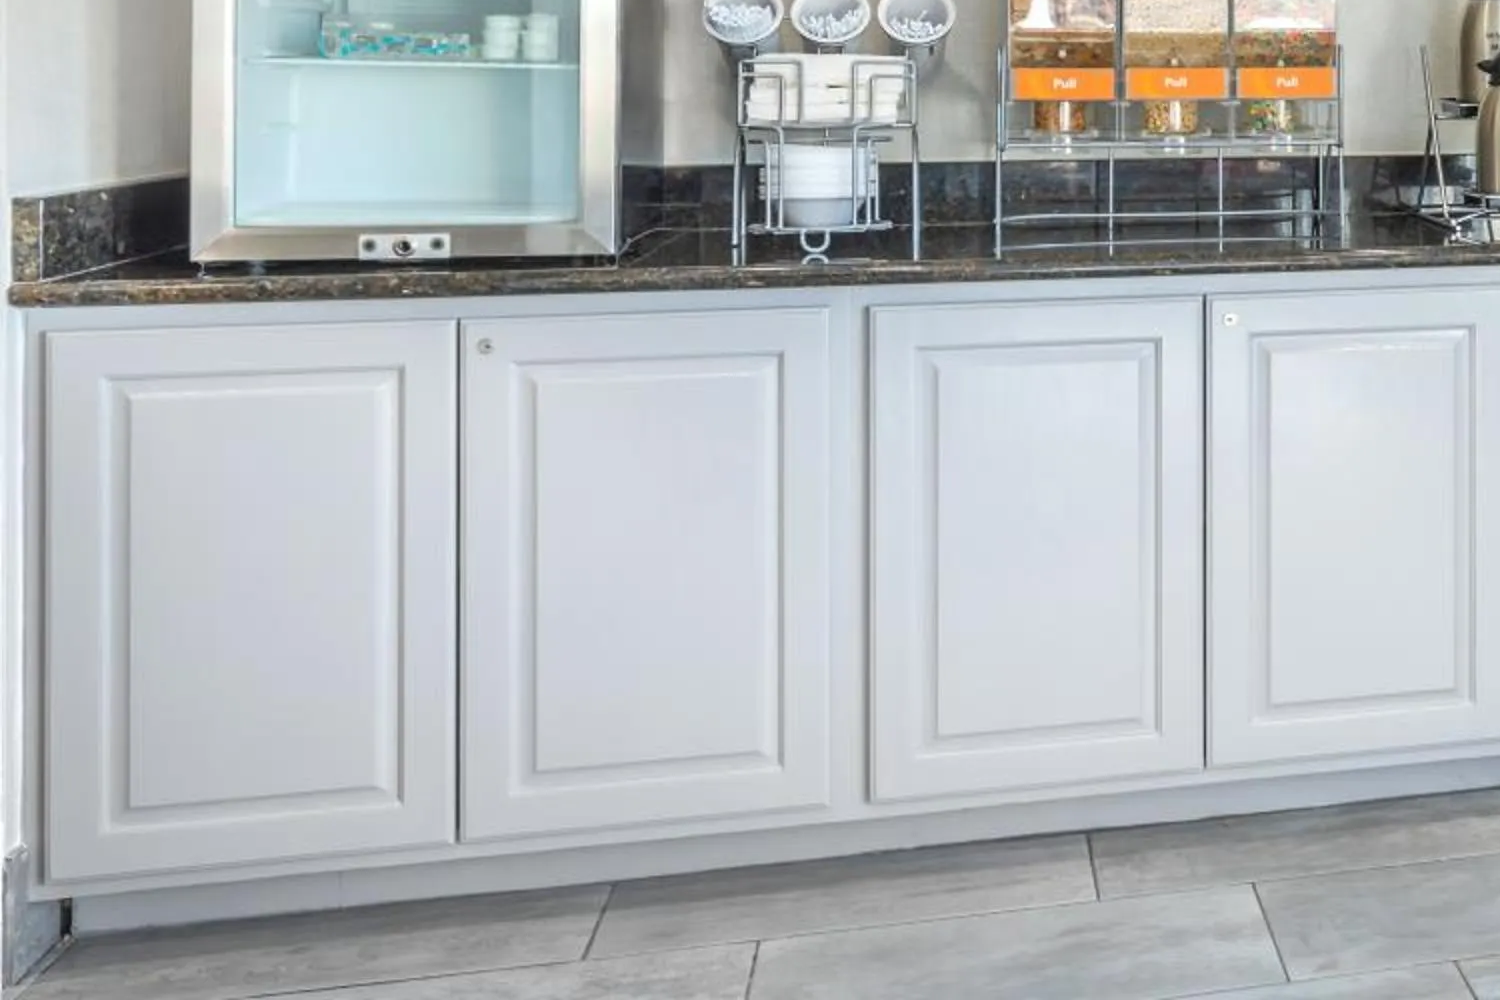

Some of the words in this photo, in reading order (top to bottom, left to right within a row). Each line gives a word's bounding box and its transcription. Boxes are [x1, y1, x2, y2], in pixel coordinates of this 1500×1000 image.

[1053, 77, 1077, 89] Pull
[1164, 76, 1188, 88] Pull
[1276, 76, 1299, 88] Pull
